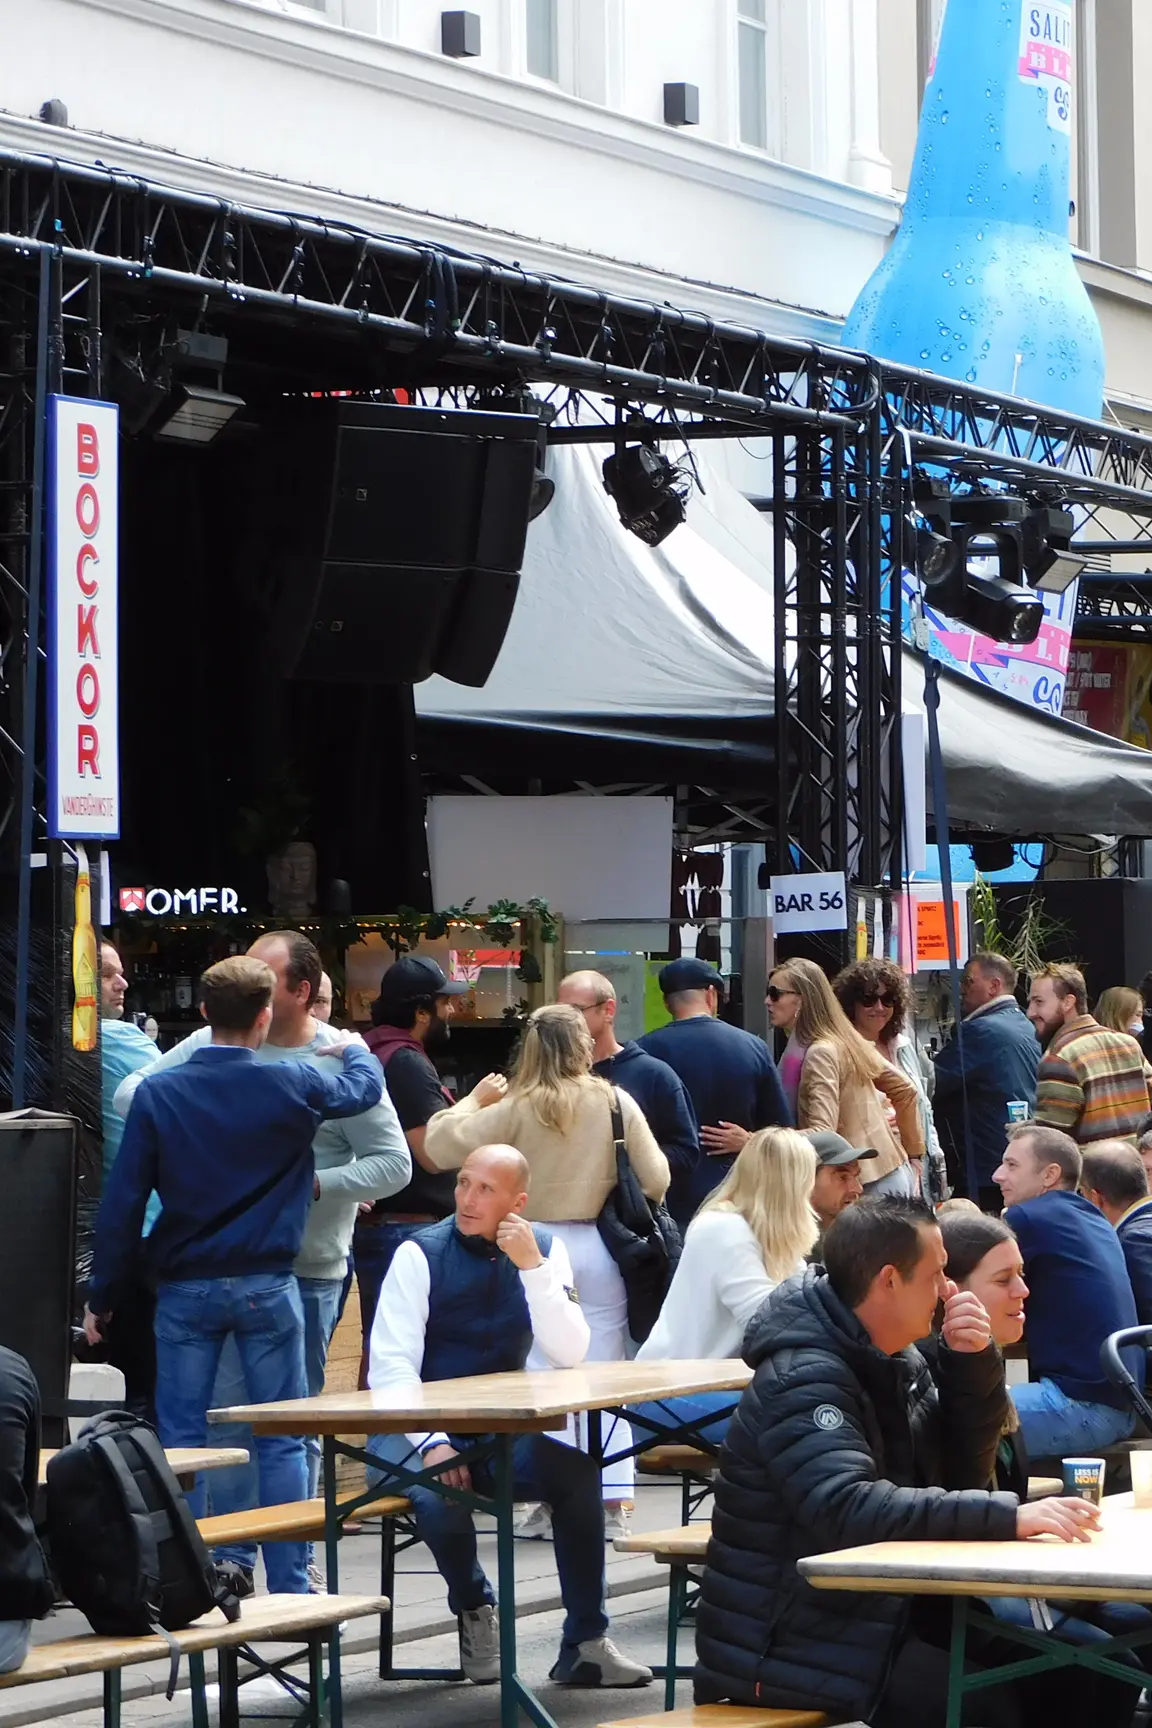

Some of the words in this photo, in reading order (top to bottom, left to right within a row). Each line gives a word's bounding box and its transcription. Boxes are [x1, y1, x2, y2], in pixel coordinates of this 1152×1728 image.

[75, 422, 101, 778] BOCKOR
[146, 887, 247, 915] OMER.
[774, 893, 815, 913] BAR
[819, 890, 844, 911] 56
[1074, 1468, 1091, 1476] LESS
[1092, 1468, 1099, 1476] IS
[1074, 1475, 1099, 1484] NOW
